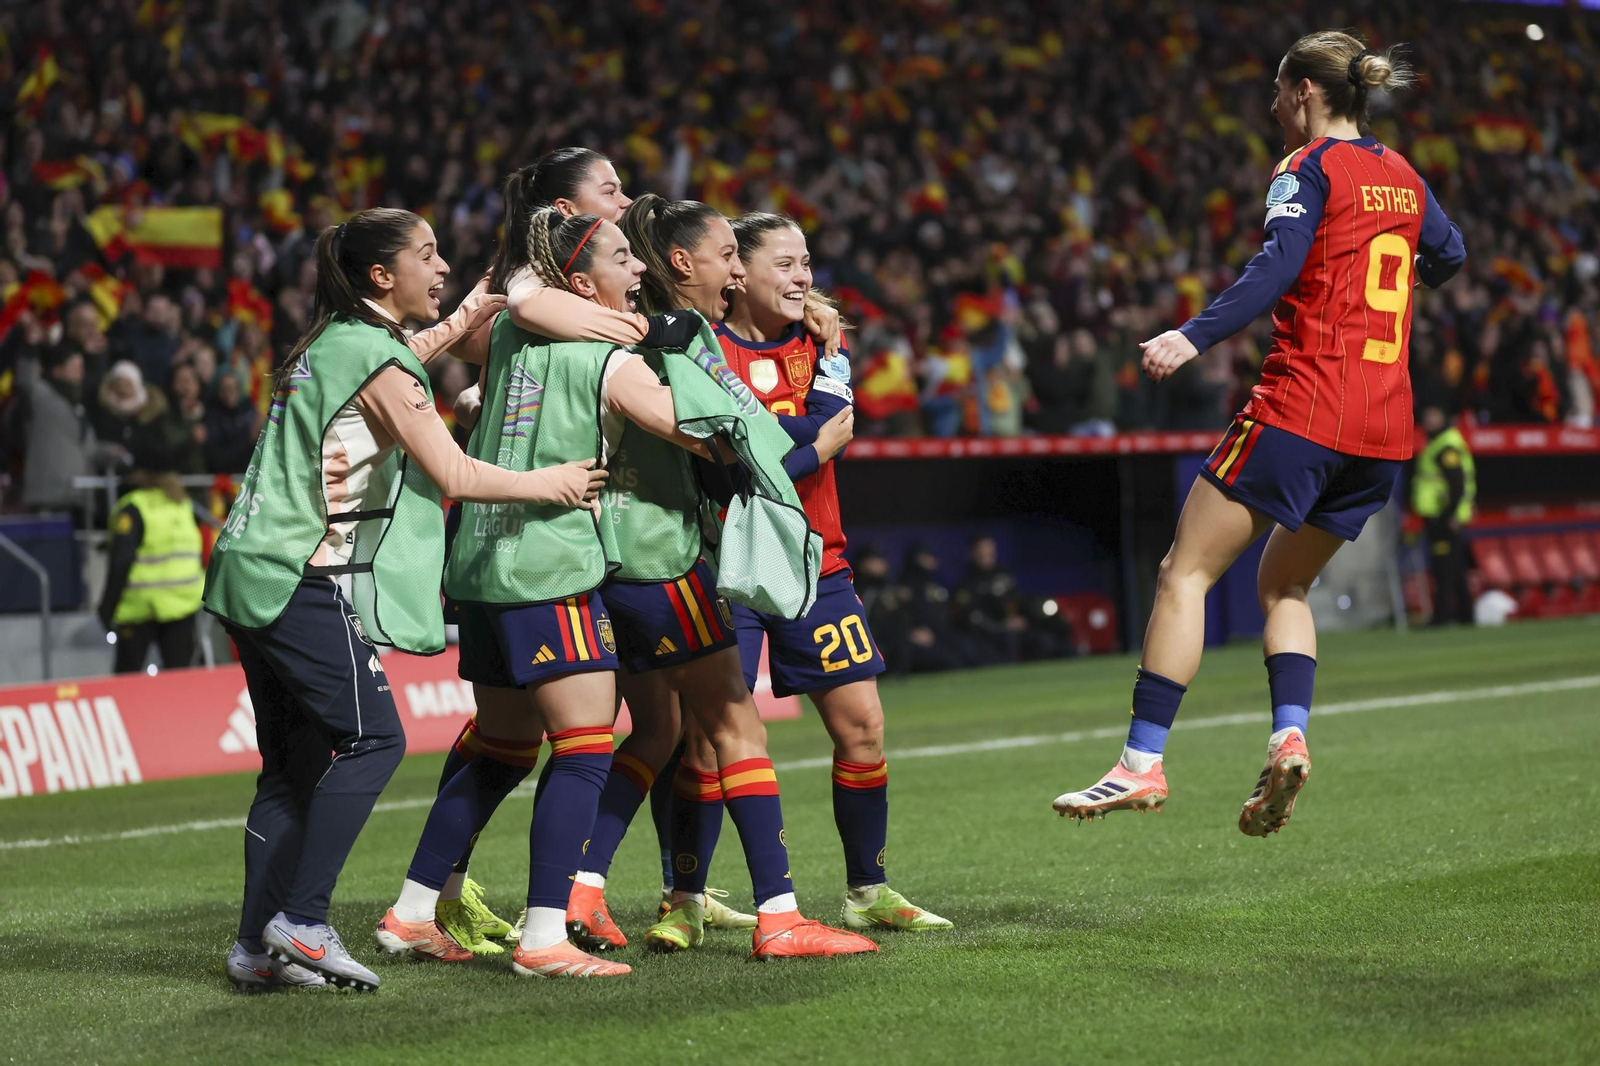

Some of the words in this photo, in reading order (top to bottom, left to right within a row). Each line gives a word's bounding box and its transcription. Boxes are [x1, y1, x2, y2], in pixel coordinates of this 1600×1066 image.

[1285, 206, 1299, 214] 10
[1360, 185, 1419, 215] ESTHER
[1361, 232, 1411, 365] 9
[813, 614, 873, 673] 20
